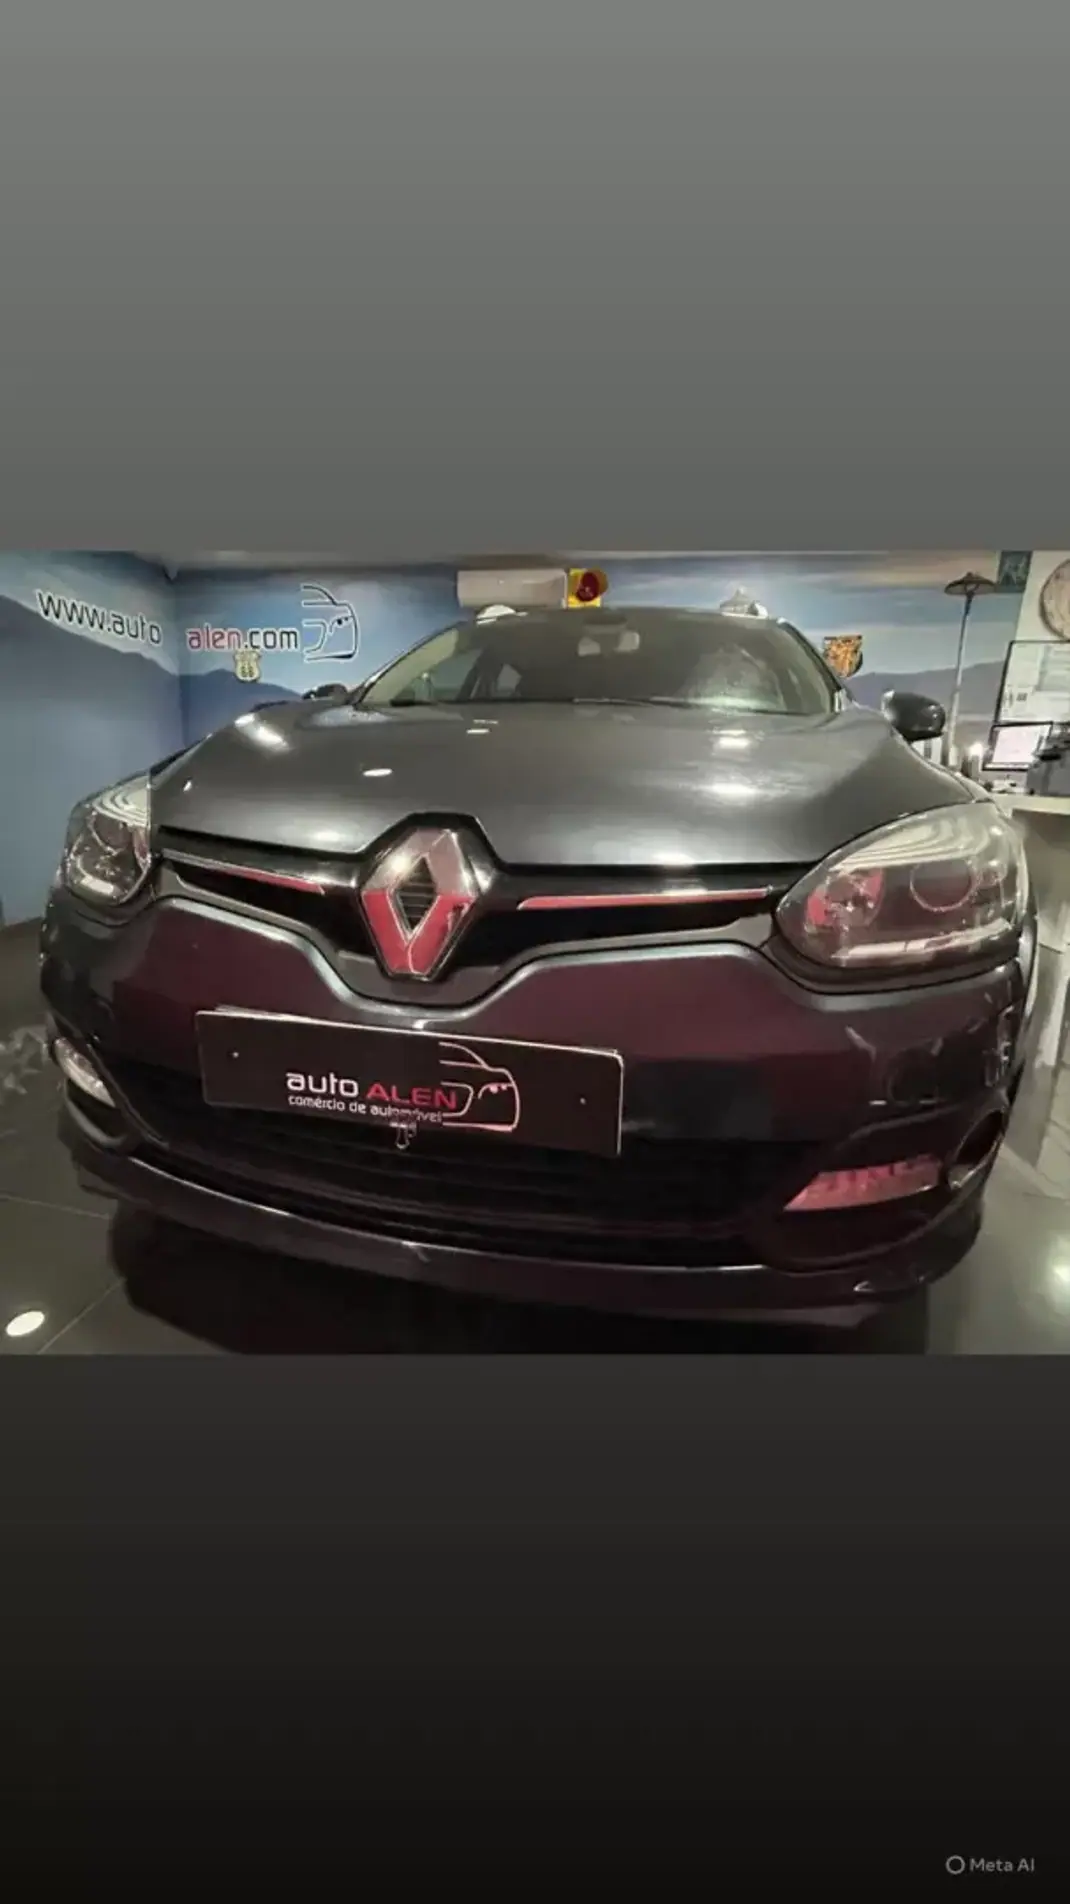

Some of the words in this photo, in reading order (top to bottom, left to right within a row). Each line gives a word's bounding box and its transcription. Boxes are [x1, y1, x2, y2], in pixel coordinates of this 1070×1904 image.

[37, 592, 162, 646] www.auto
[188, 625, 298, 650] alen.com
[286, 1072, 359, 1098] auto
[366, 1082, 457, 1111] ALEN
[288, 1095, 346, 1112] comércio
[348, 1101, 367, 1115] de
